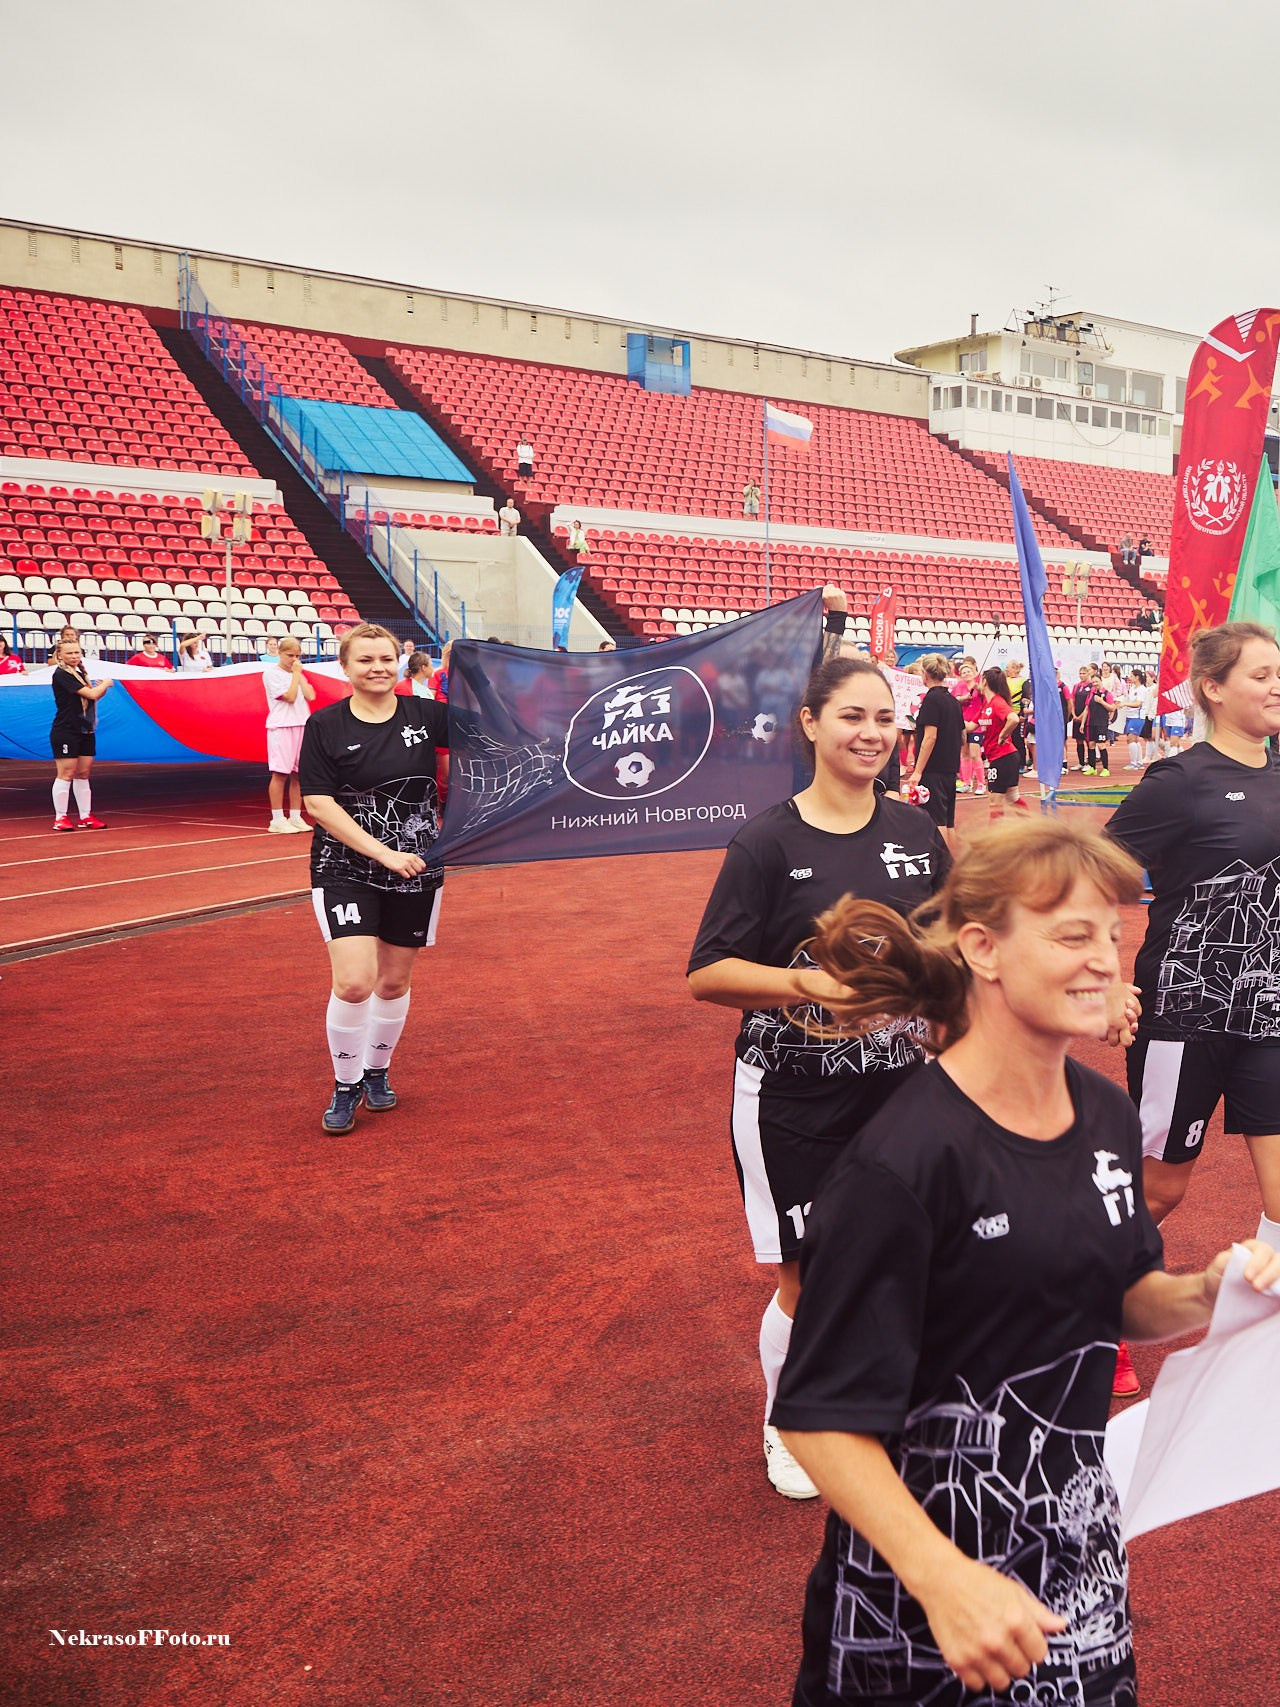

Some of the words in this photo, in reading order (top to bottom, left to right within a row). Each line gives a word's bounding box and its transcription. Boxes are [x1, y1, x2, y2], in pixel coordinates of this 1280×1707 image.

[875, 612, 884, 653] ОСНОВА
[602, 693, 671, 730] ГАЗ
[592, 722, 674, 751] ЧАЙКА
[551, 808, 639, 830] Нижний
[645, 803, 747, 823] Новгород
[331, 902, 361, 926] 14
[1184, 1119, 1205, 1148] 8
